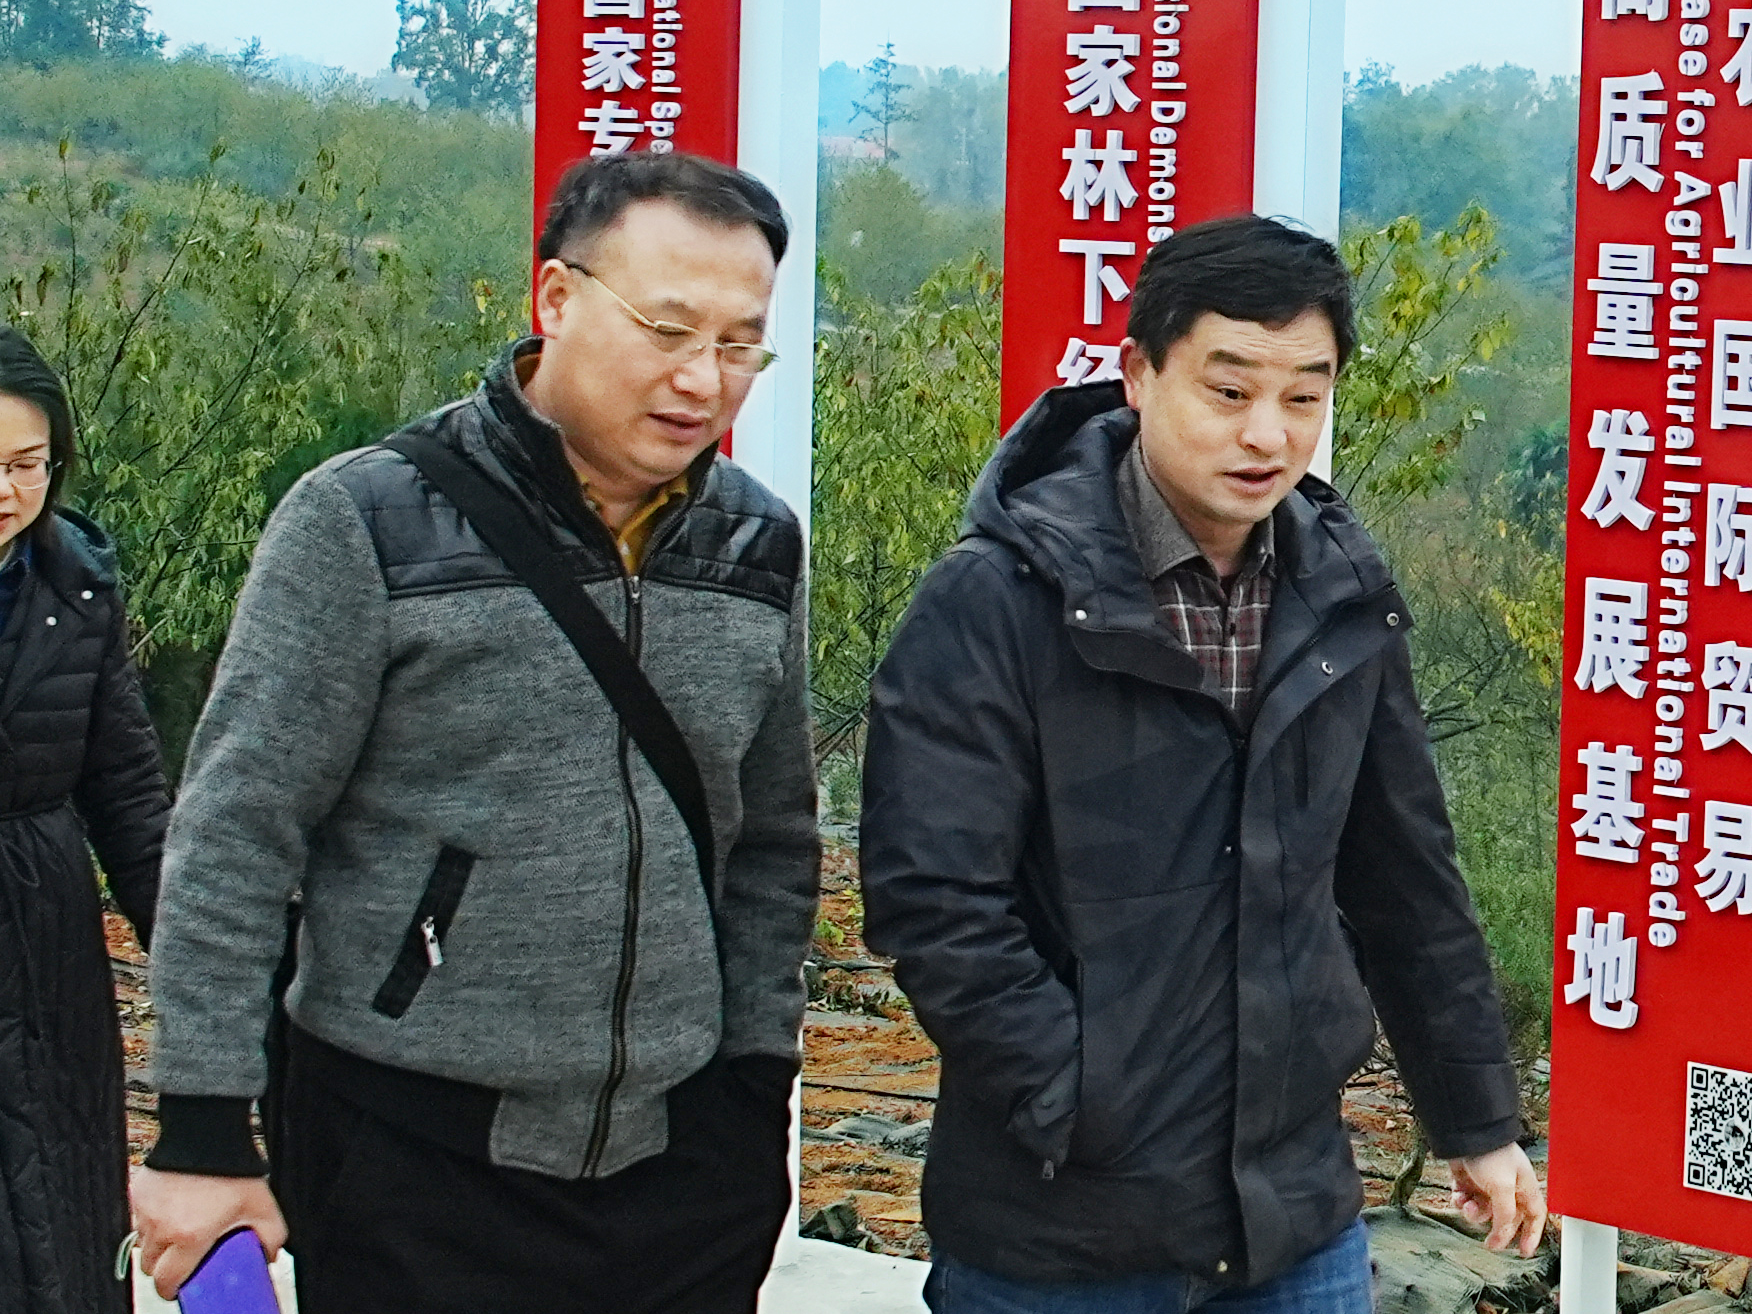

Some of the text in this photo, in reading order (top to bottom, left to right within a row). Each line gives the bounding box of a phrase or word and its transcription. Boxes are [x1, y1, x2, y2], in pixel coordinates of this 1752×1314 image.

[1147, 100, 1187, 255] Demons
[1675, 89, 1715, 158] for
[1665, 171, 1711, 466] Agricultural
[1653, 481, 1701, 798] International
[1649, 813, 1689, 947] Trade
